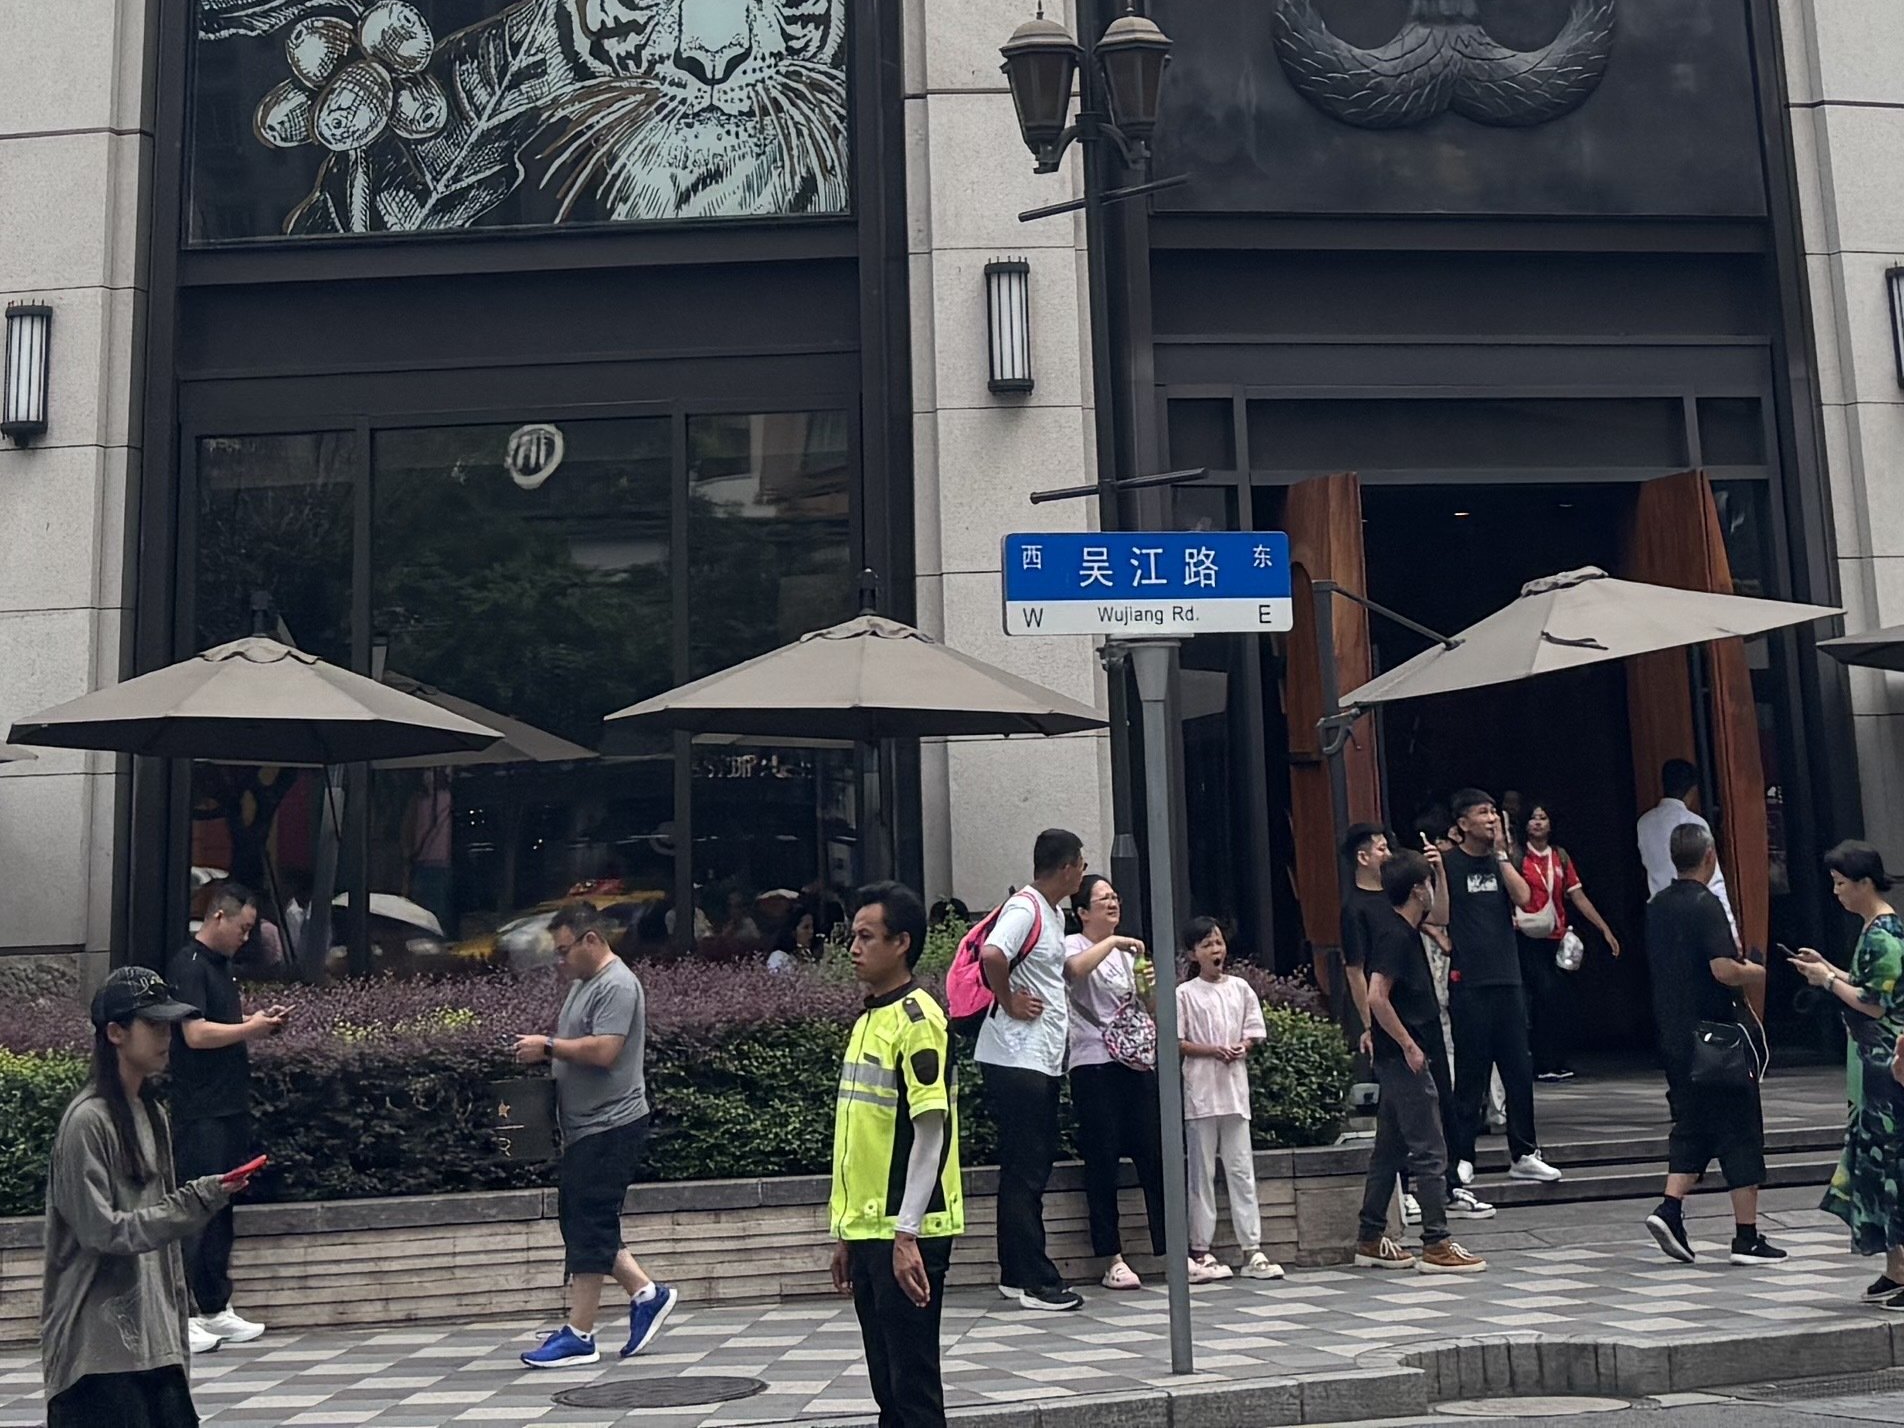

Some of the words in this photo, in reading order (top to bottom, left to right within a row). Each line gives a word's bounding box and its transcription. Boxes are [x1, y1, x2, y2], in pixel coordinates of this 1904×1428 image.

[1021, 545, 1042, 571] 西
[1078, 545, 1220, 589] 吴江路
[1252, 543, 1273, 569] 东
[1022, 607, 1045, 628] W
[1097, 606, 1164, 625] Wujiang
[1172, 606, 1200, 622] Rd.
[1258, 604, 1272, 624] E
